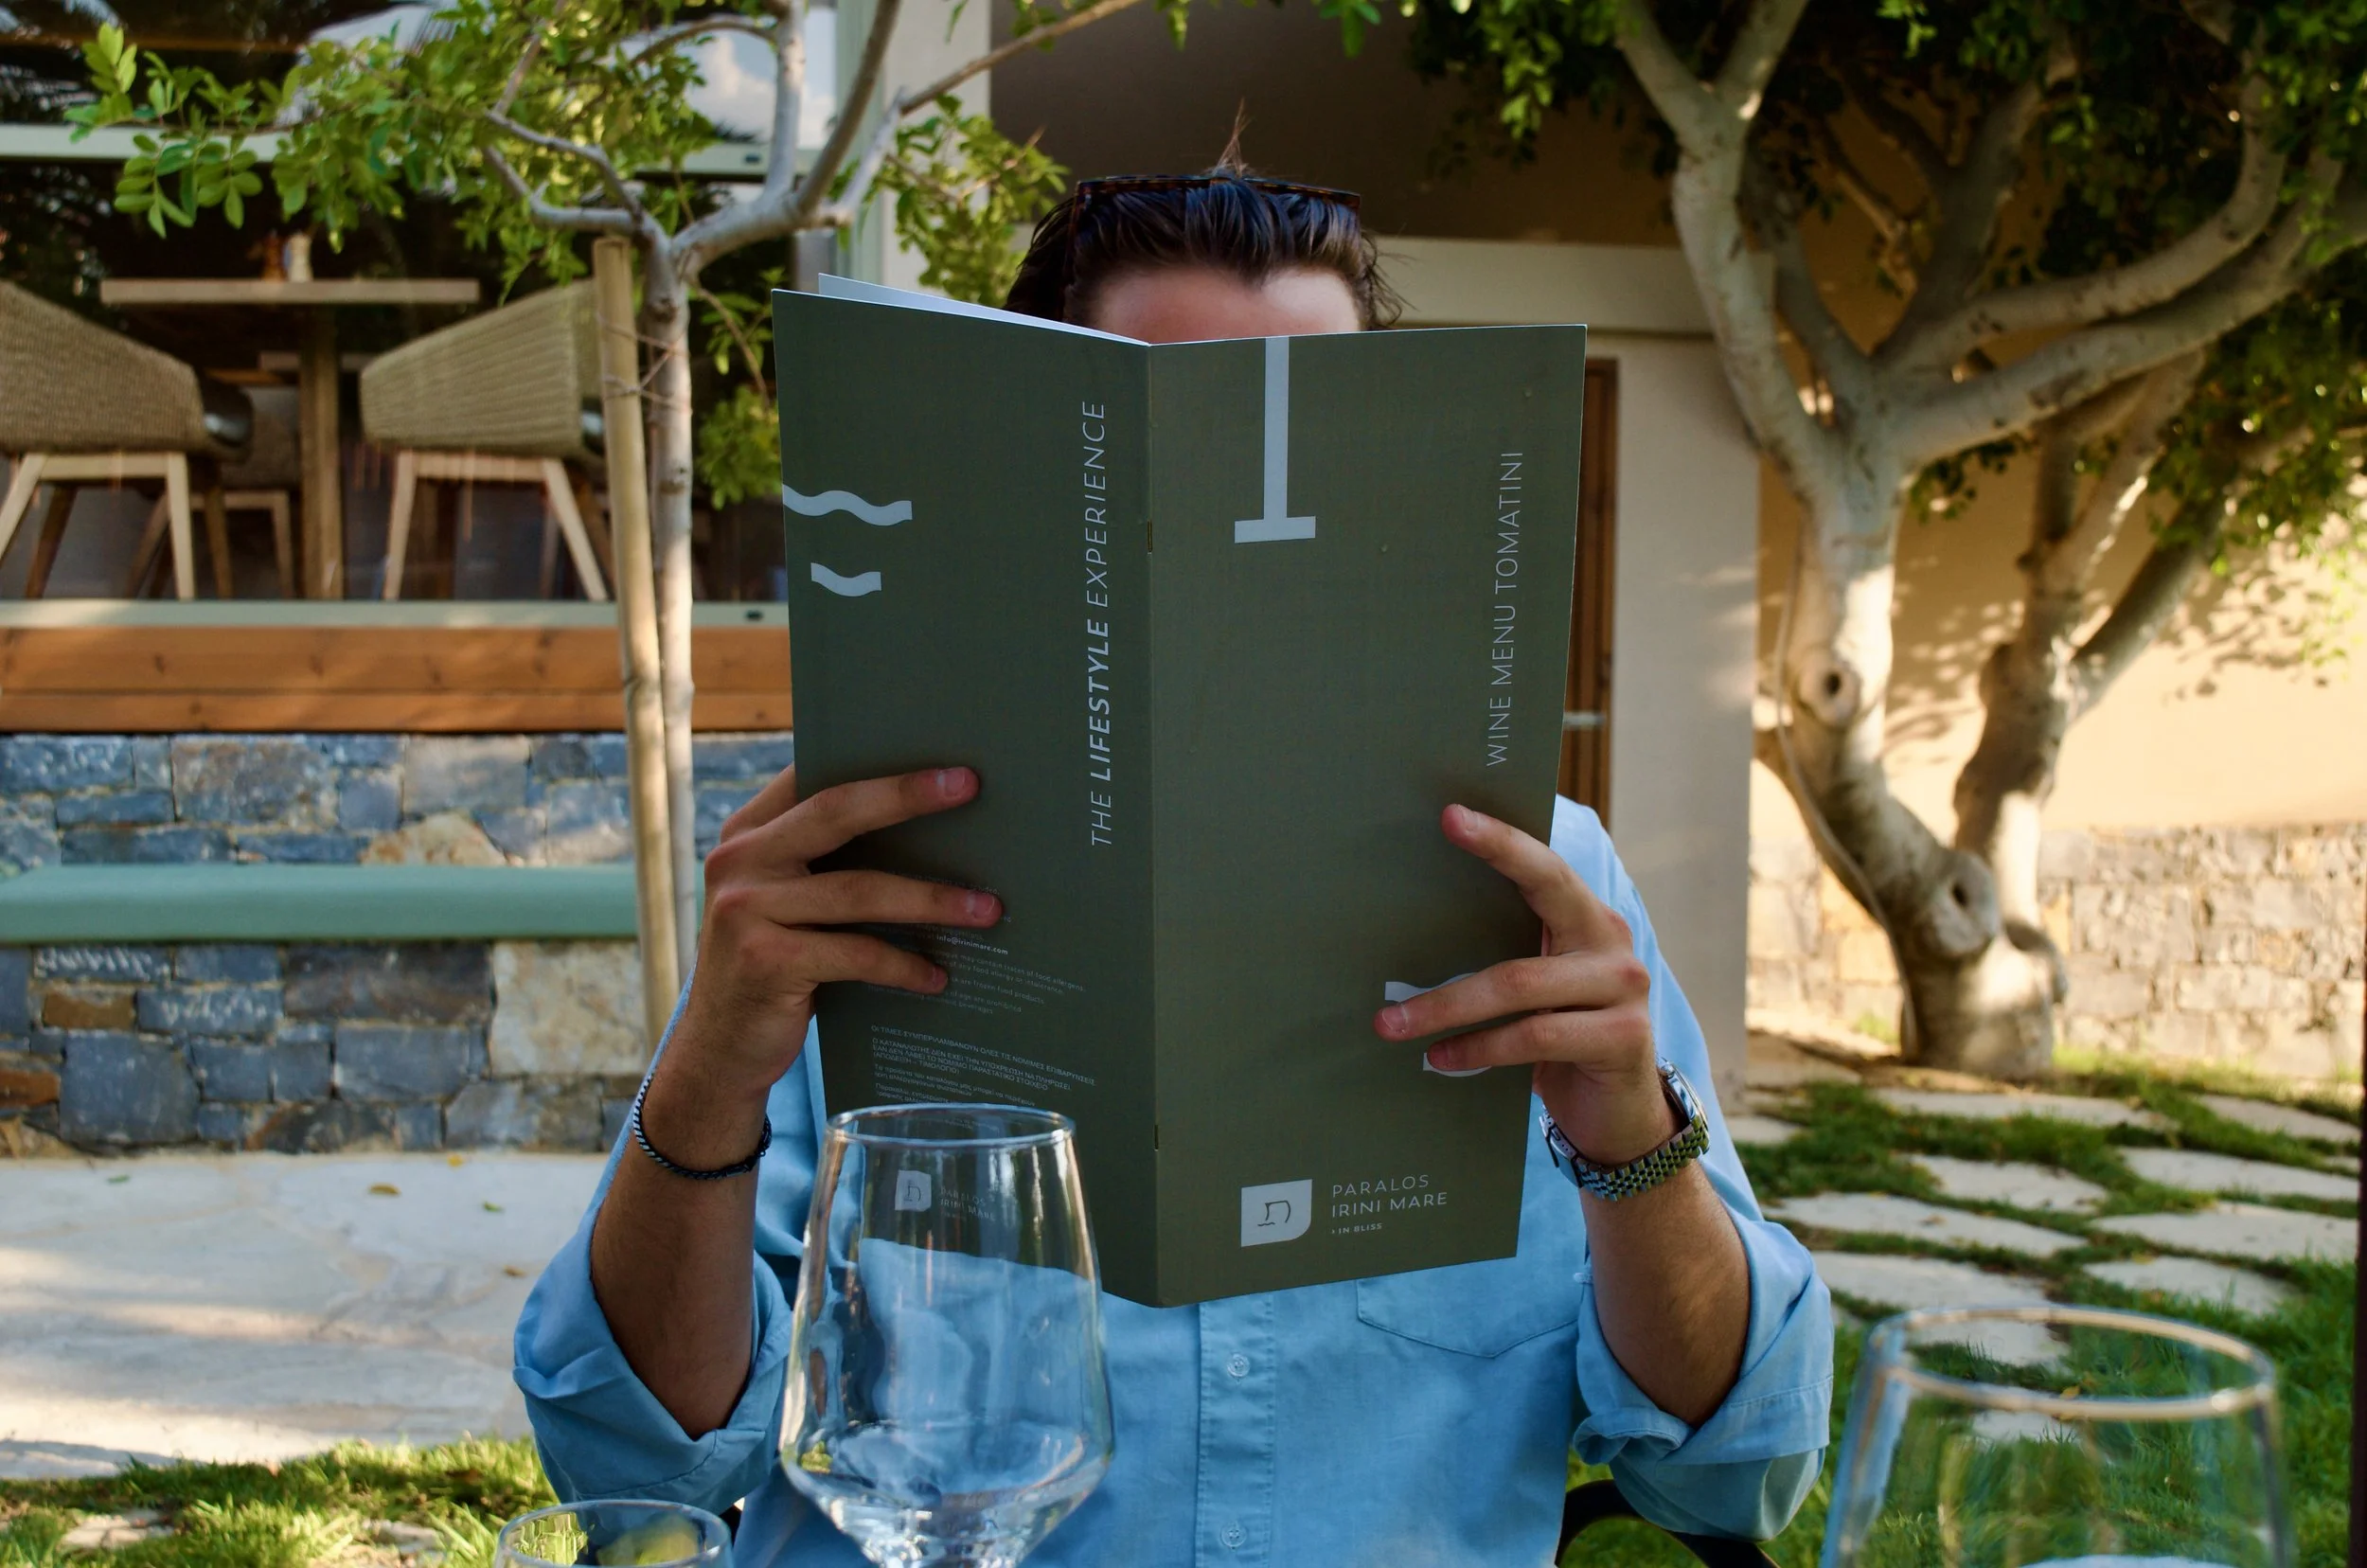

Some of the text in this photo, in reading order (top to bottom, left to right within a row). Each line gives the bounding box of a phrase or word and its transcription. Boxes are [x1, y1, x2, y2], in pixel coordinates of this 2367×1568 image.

[1486, 453, 1523, 767] WINE MENU TOMATINI
[1081, 401, 1112, 846] THE LIFESTYLE EXPERIENCE
[936, 935, 1008, 955] info@irinimare.com
[1332, 1174, 1430, 1198] PARALOS
[1332, 1191, 1448, 1219] IRINI MARE
[1338, 1222, 1383, 1235] IN BLISS
